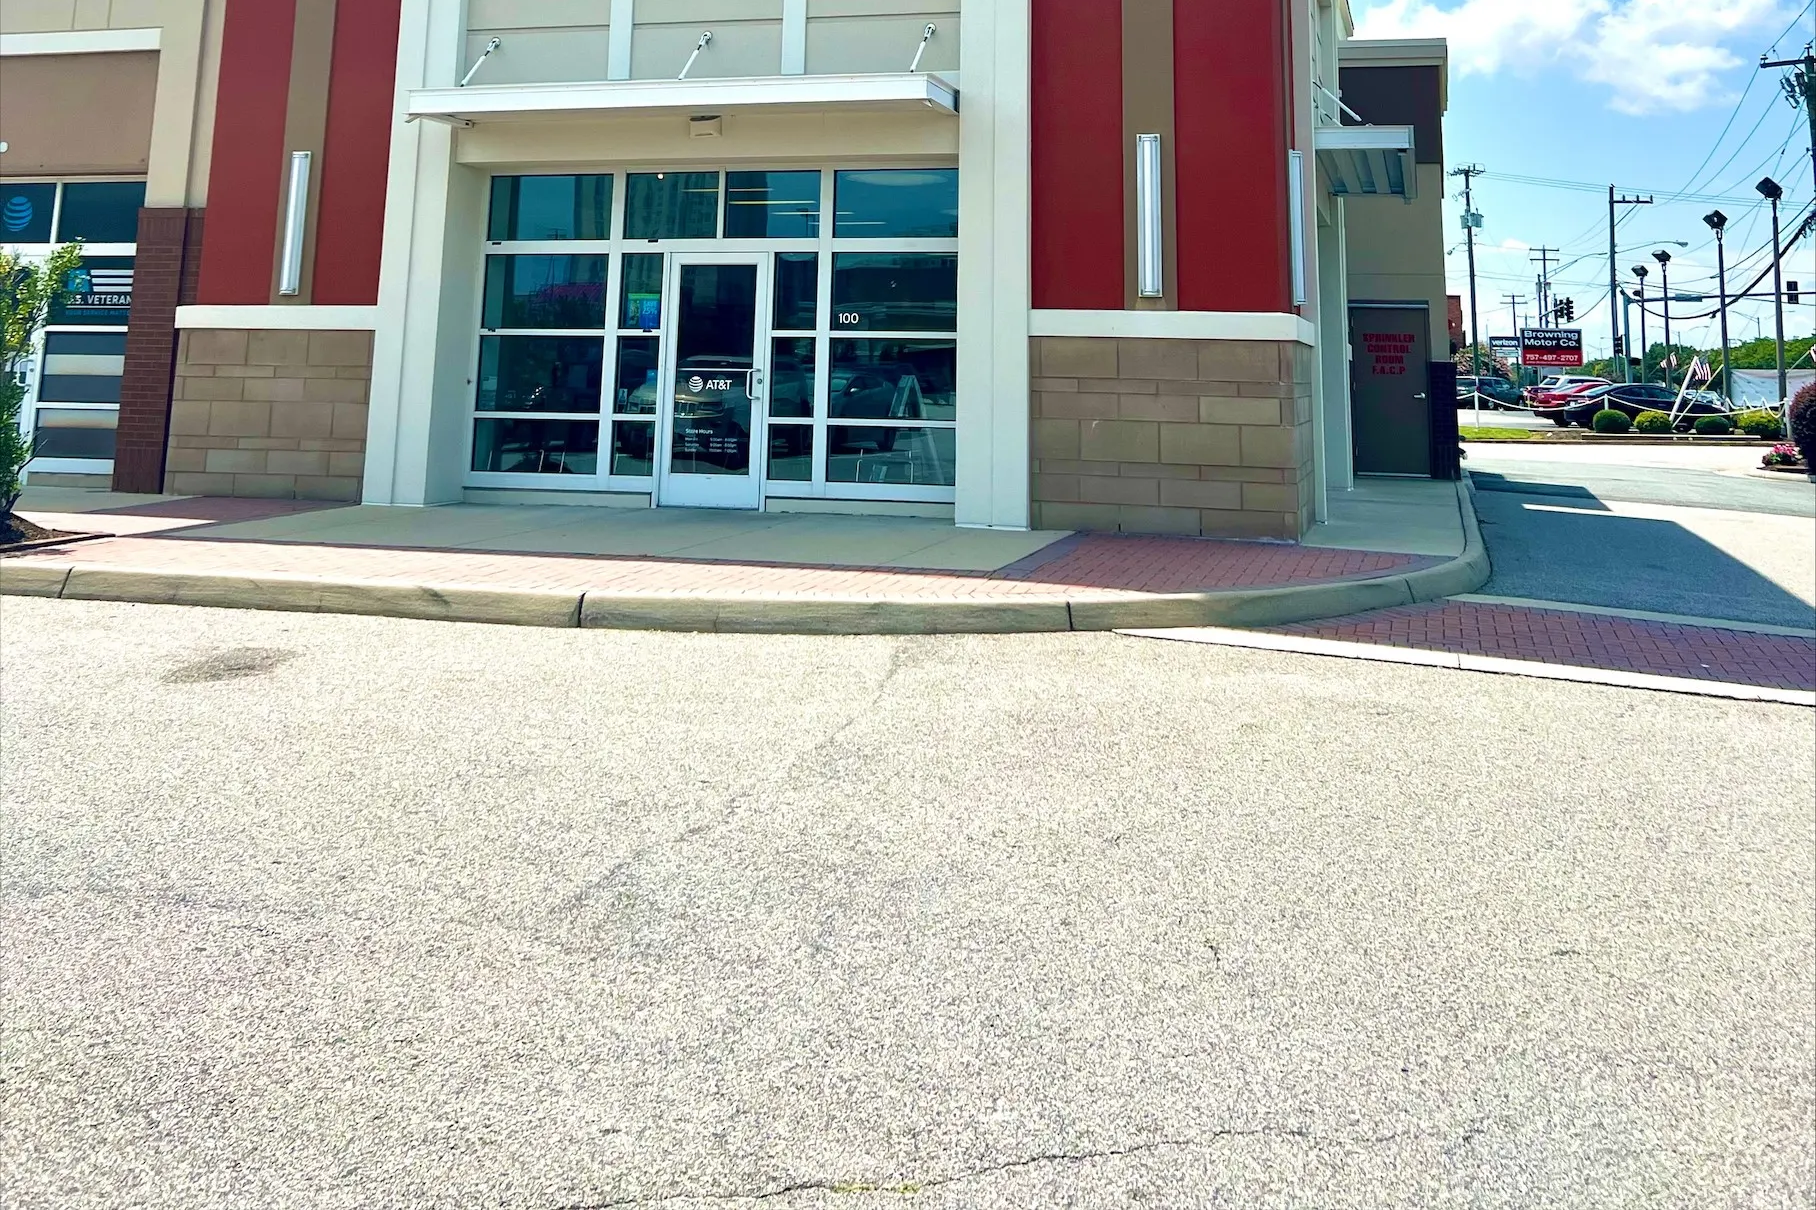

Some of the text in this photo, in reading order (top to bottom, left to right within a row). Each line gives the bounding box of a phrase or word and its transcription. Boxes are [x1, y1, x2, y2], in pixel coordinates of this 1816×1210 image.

[838, 312, 859, 324] 100
[1362, 333, 1416, 343] SPRINKLER
[1524, 330, 1578, 340] Browning
[1492, 338, 1518, 346] verizon
[1367, 343, 1412, 353] CONTROL
[1375, 355, 1404, 364] ROOM
[706, 379, 733, 391] AT&T
